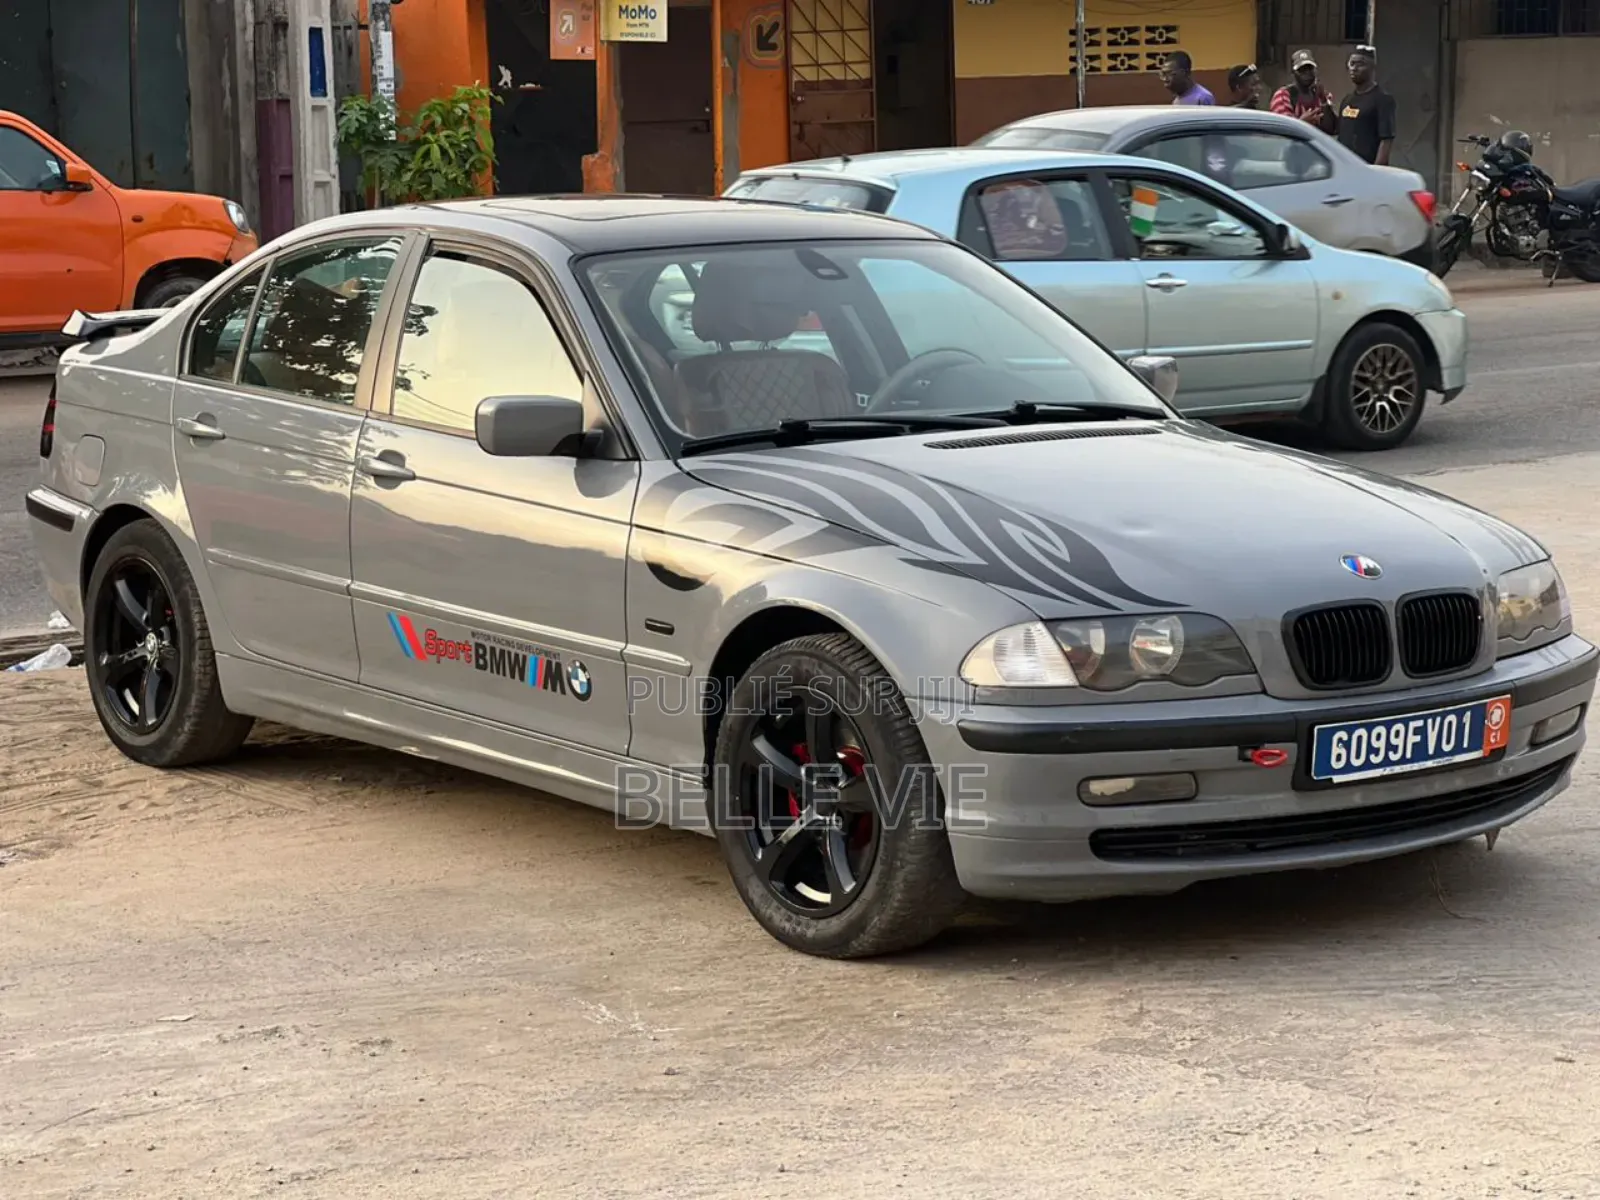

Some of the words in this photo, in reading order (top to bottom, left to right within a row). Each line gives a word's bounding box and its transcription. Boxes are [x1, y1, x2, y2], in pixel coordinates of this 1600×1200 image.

[618, 4, 657, 20] MoMo
[424, 629, 473, 664] Sport
[474, 642, 528, 682] BMW
[542, 660, 567, 695] M
[1330, 710, 1472, 770] 6099FV01
